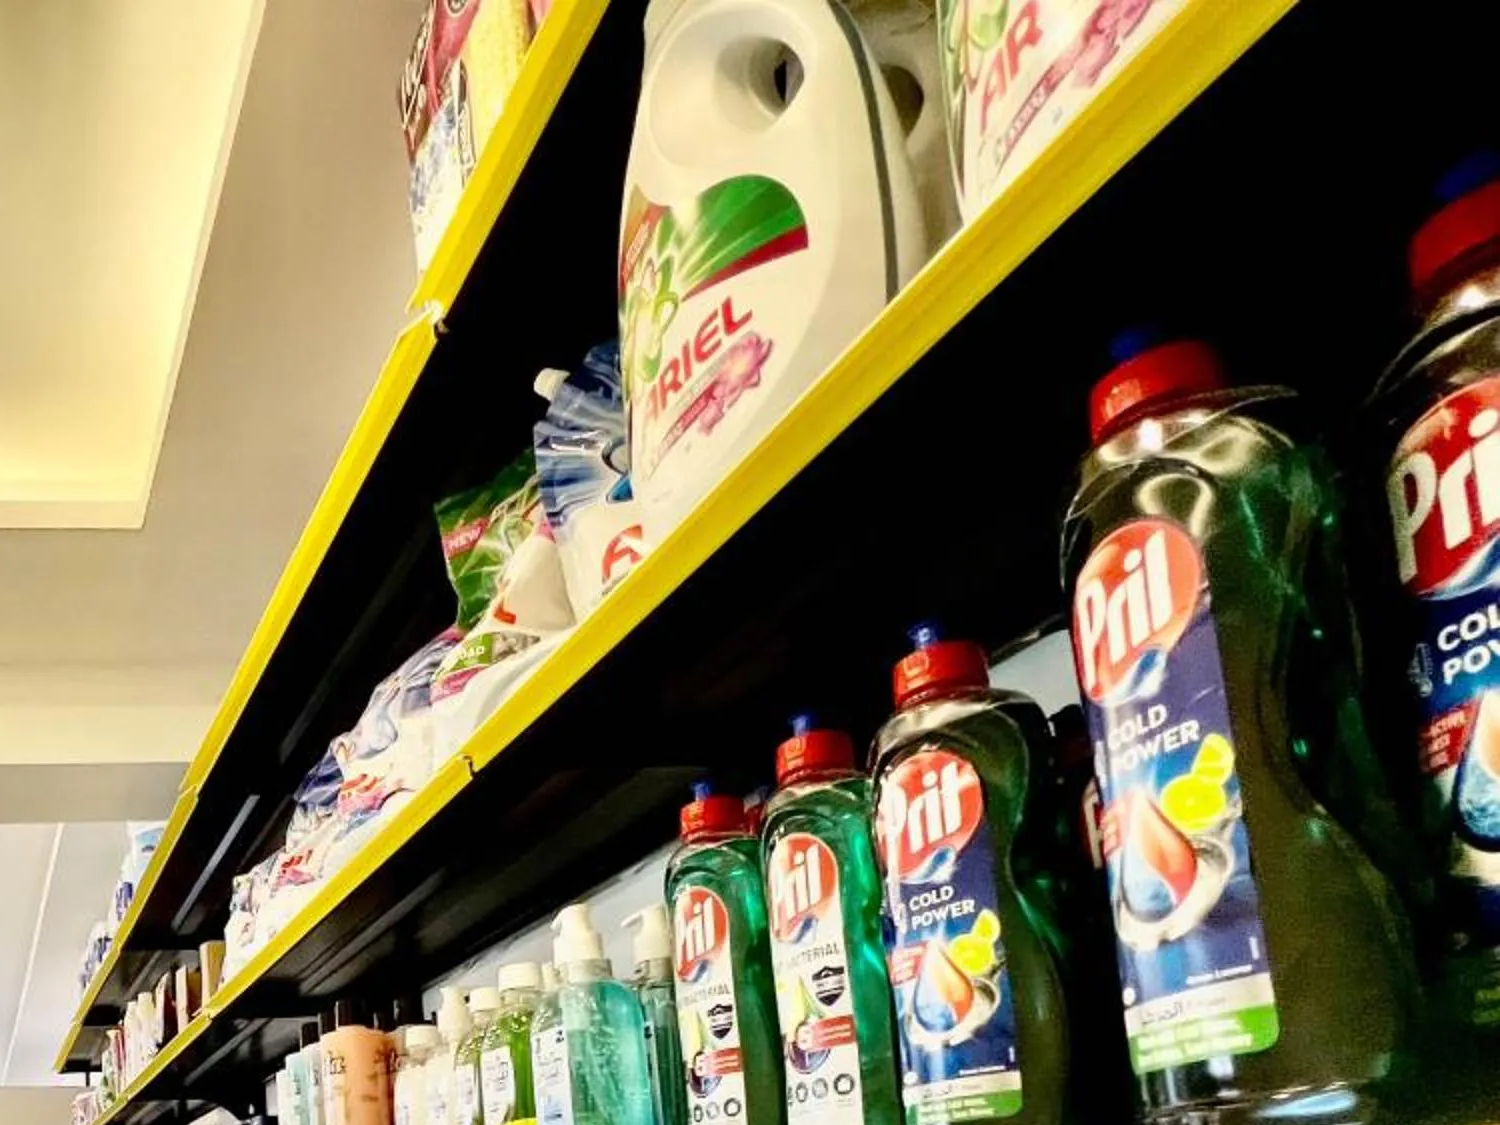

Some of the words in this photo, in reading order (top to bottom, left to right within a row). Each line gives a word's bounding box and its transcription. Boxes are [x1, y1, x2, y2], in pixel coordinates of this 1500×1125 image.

[1076, 528, 1173, 694] Pril
[1107, 703, 1168, 751] COLD
[1111, 719, 1200, 772] OWER
[877, 760, 964, 876] Pril
[769, 843, 822, 938] Pril
[909, 886, 955, 912] COLD
[911, 899, 976, 930] POWER
